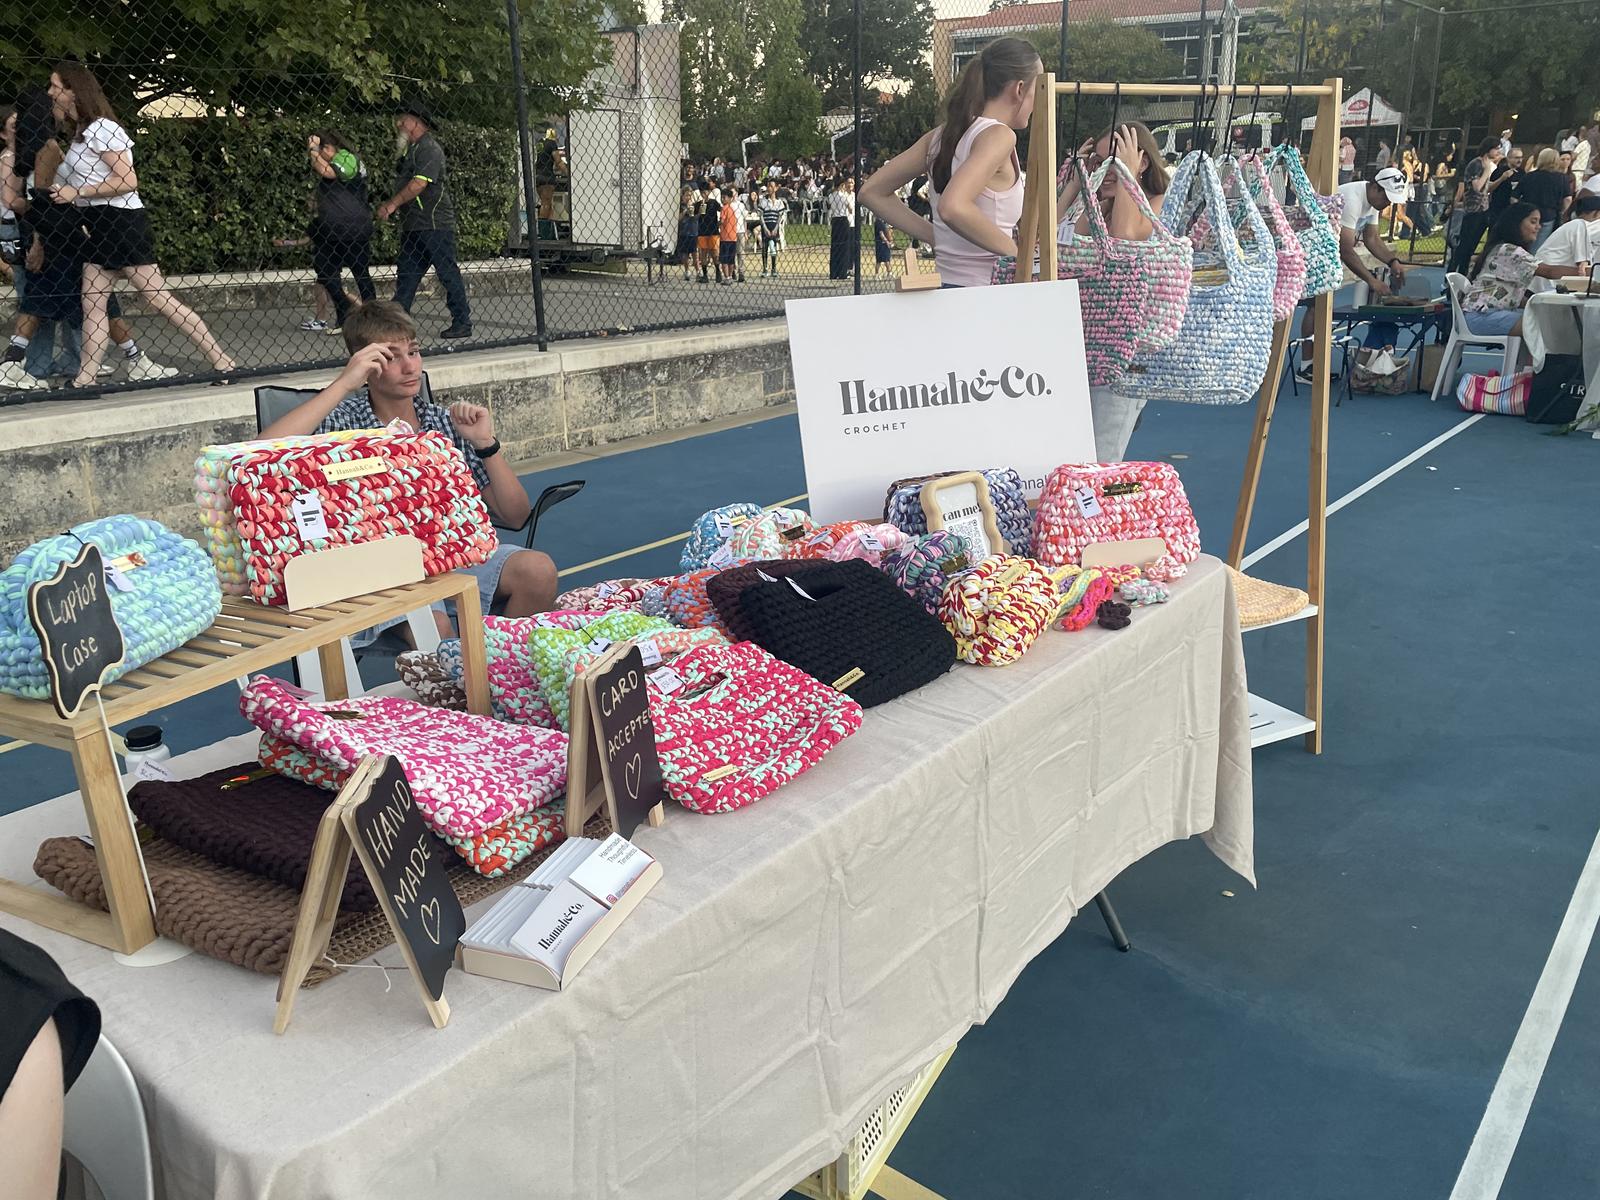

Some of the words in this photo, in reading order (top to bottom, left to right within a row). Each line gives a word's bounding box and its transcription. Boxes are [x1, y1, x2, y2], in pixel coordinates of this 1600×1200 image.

[838, 365, 1052, 416] Hannah&Co.
[844, 422, 908, 436] CROCHET
[61, 635, 98, 673] Case
[601, 670, 638, 717] CARD
[366, 779, 411, 868] HAND
[393, 833, 431, 919] MADE
[537, 903, 584, 950] Hannah&Co.
